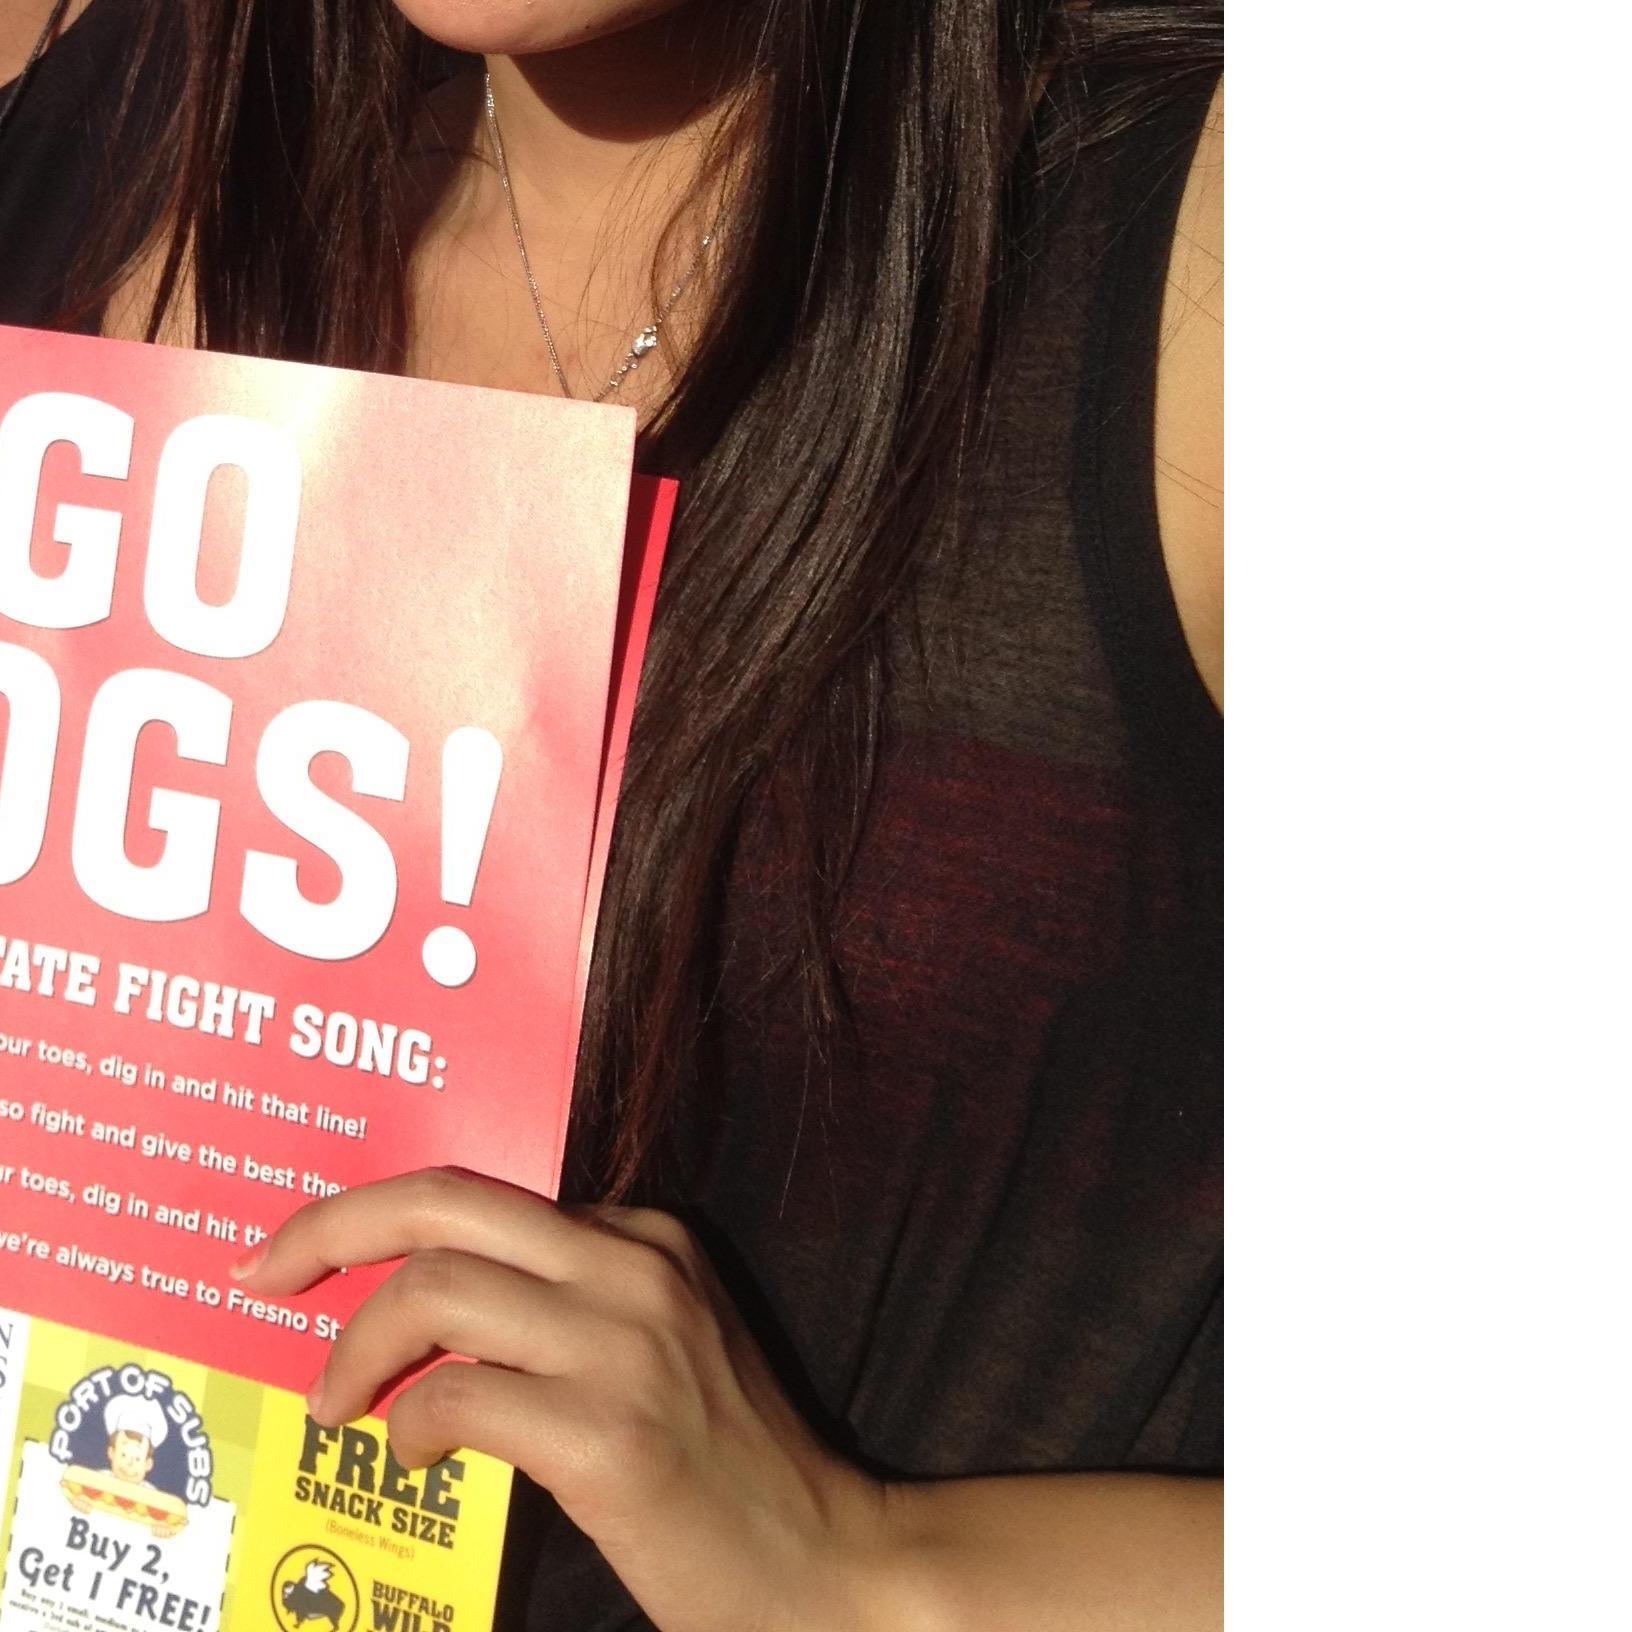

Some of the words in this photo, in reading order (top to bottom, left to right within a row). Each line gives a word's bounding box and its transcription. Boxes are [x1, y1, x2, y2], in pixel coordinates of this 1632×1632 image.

[112, 964, 277, 1046] FIGHT
[289, 1004, 450, 1091] SONG:
[37, 1039, 93, 1074] toes,
[99, 1053, 138, 1086] dig
[144, 1063, 166, 1090] in
[171, 1075, 217, 1102] and
[222, 1082, 256, 1112] hit
[261, 1093, 310, 1125] that
[315, 1105, 368, 1140] line!
[30, 1102, 85, 1137] fight
[90, 1120, 137, 1149] and
[141, 1133, 192, 1163] give
[197, 1144, 237, 1174] the
[243, 1155, 296, 1191] best
[302, 1172, 348, 1199] the
[20, 1166, 76, 1203] toes,
[82, 1182, 121, 1215] dig
[127, 1193, 149, 1218] in
[154, 1205, 201, 1233] and
[205, 1213, 237, 1243] hit
[56, 1244, 135, 1284] always
[140, 1265, 190, 1298] true
[195, 1279, 221, 1307] to
[227, 1288, 309, 1333] Fresno
[315, 1313, 344, 1341] St
[50, 1369, 114, 1461] PORT
[119, 1365, 171, 1399] OF
[166, 1394, 211, 1505] SUBS
[66, 1516, 131, 1571] Buy
[141, 1544, 170, 1584] 2,
[295, 1476, 384, 1526] SNACK
[391, 1506, 456, 1550] SIZE
[325, 1519, 376, 1548] (Boneless
[378, 1536, 416, 1561] Wings)
[19, 1547, 74, 1592] Get
[116, 1577, 212, 1632] FREE!
[372, 1578, 455, 1623] BUFFALO
